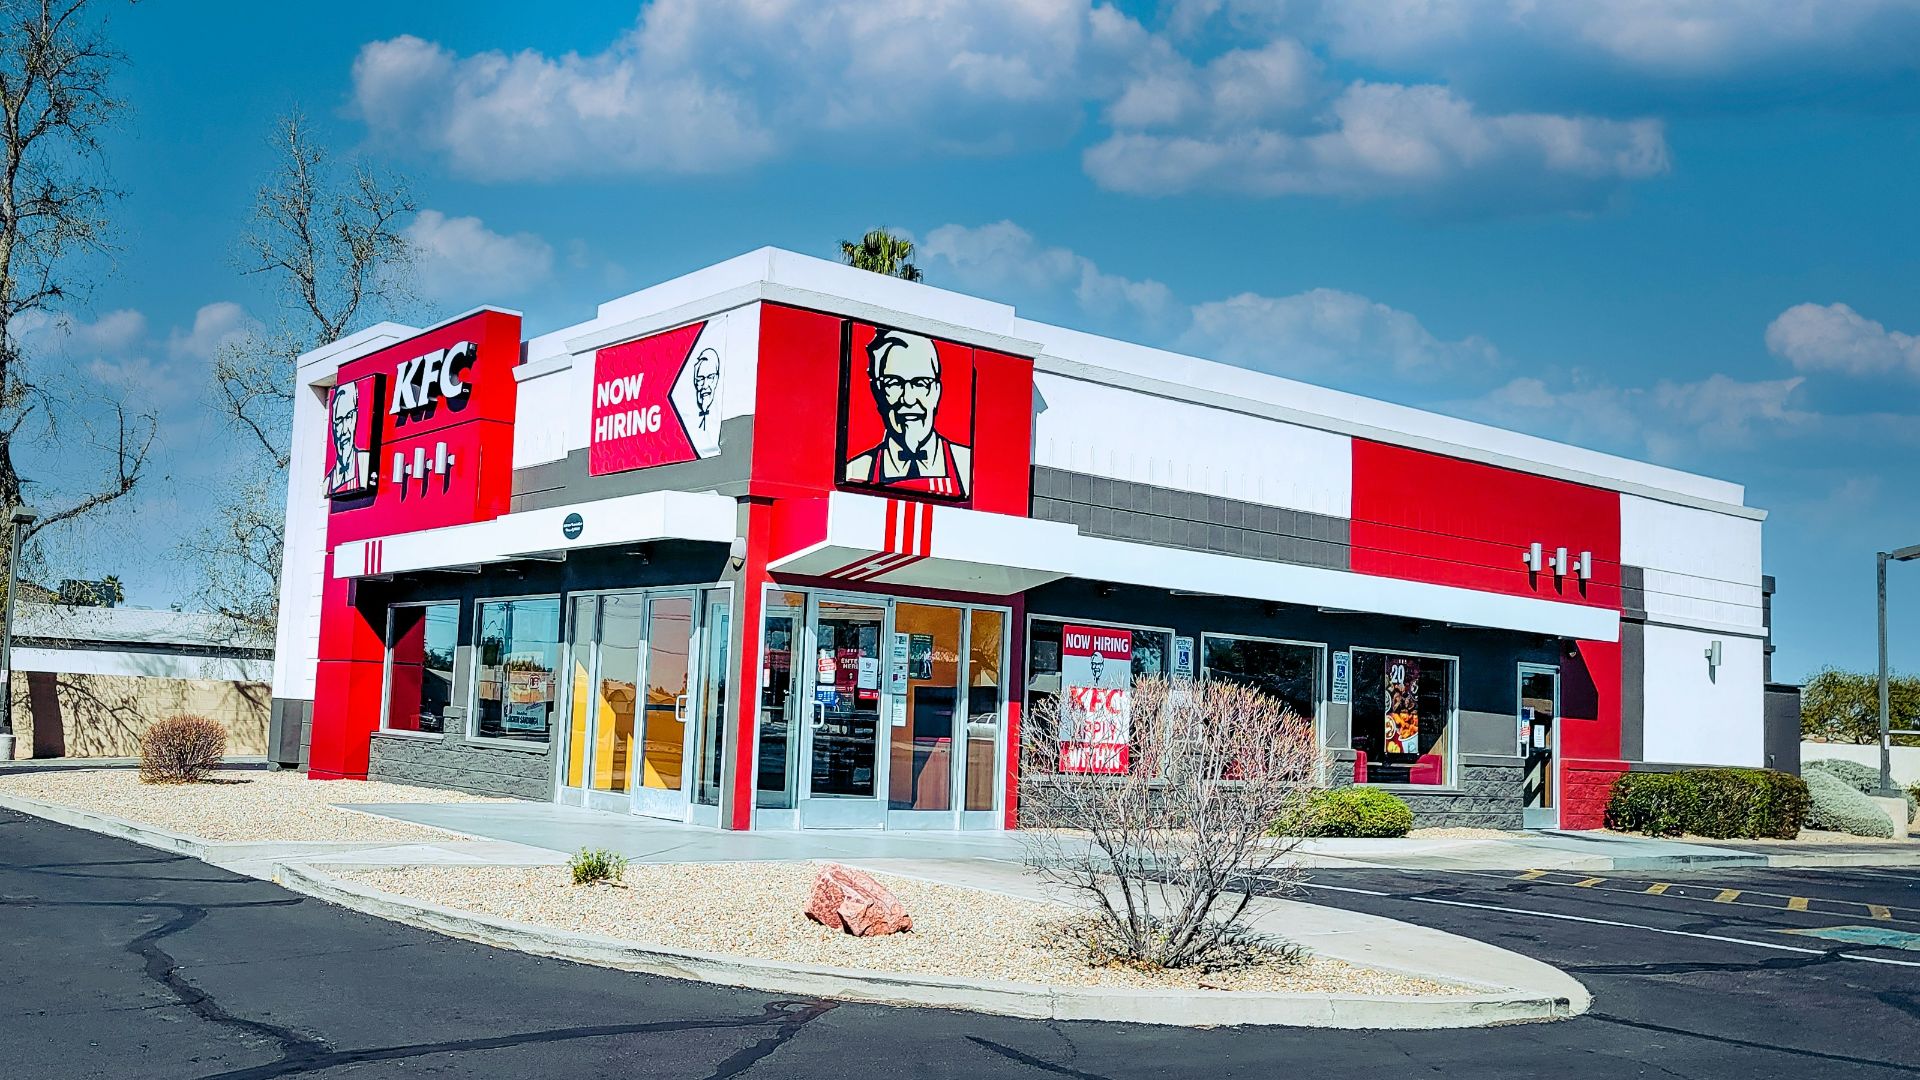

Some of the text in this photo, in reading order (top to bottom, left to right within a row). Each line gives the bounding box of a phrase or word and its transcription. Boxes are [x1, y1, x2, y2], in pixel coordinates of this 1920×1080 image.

[389, 341, 469, 414] KFC
[596, 372, 645, 408] NOW
[595, 404, 661, 443] HIRING
[1065, 633, 1129, 653] NOW HIRING
[1069, 687, 1123, 714] KFC
